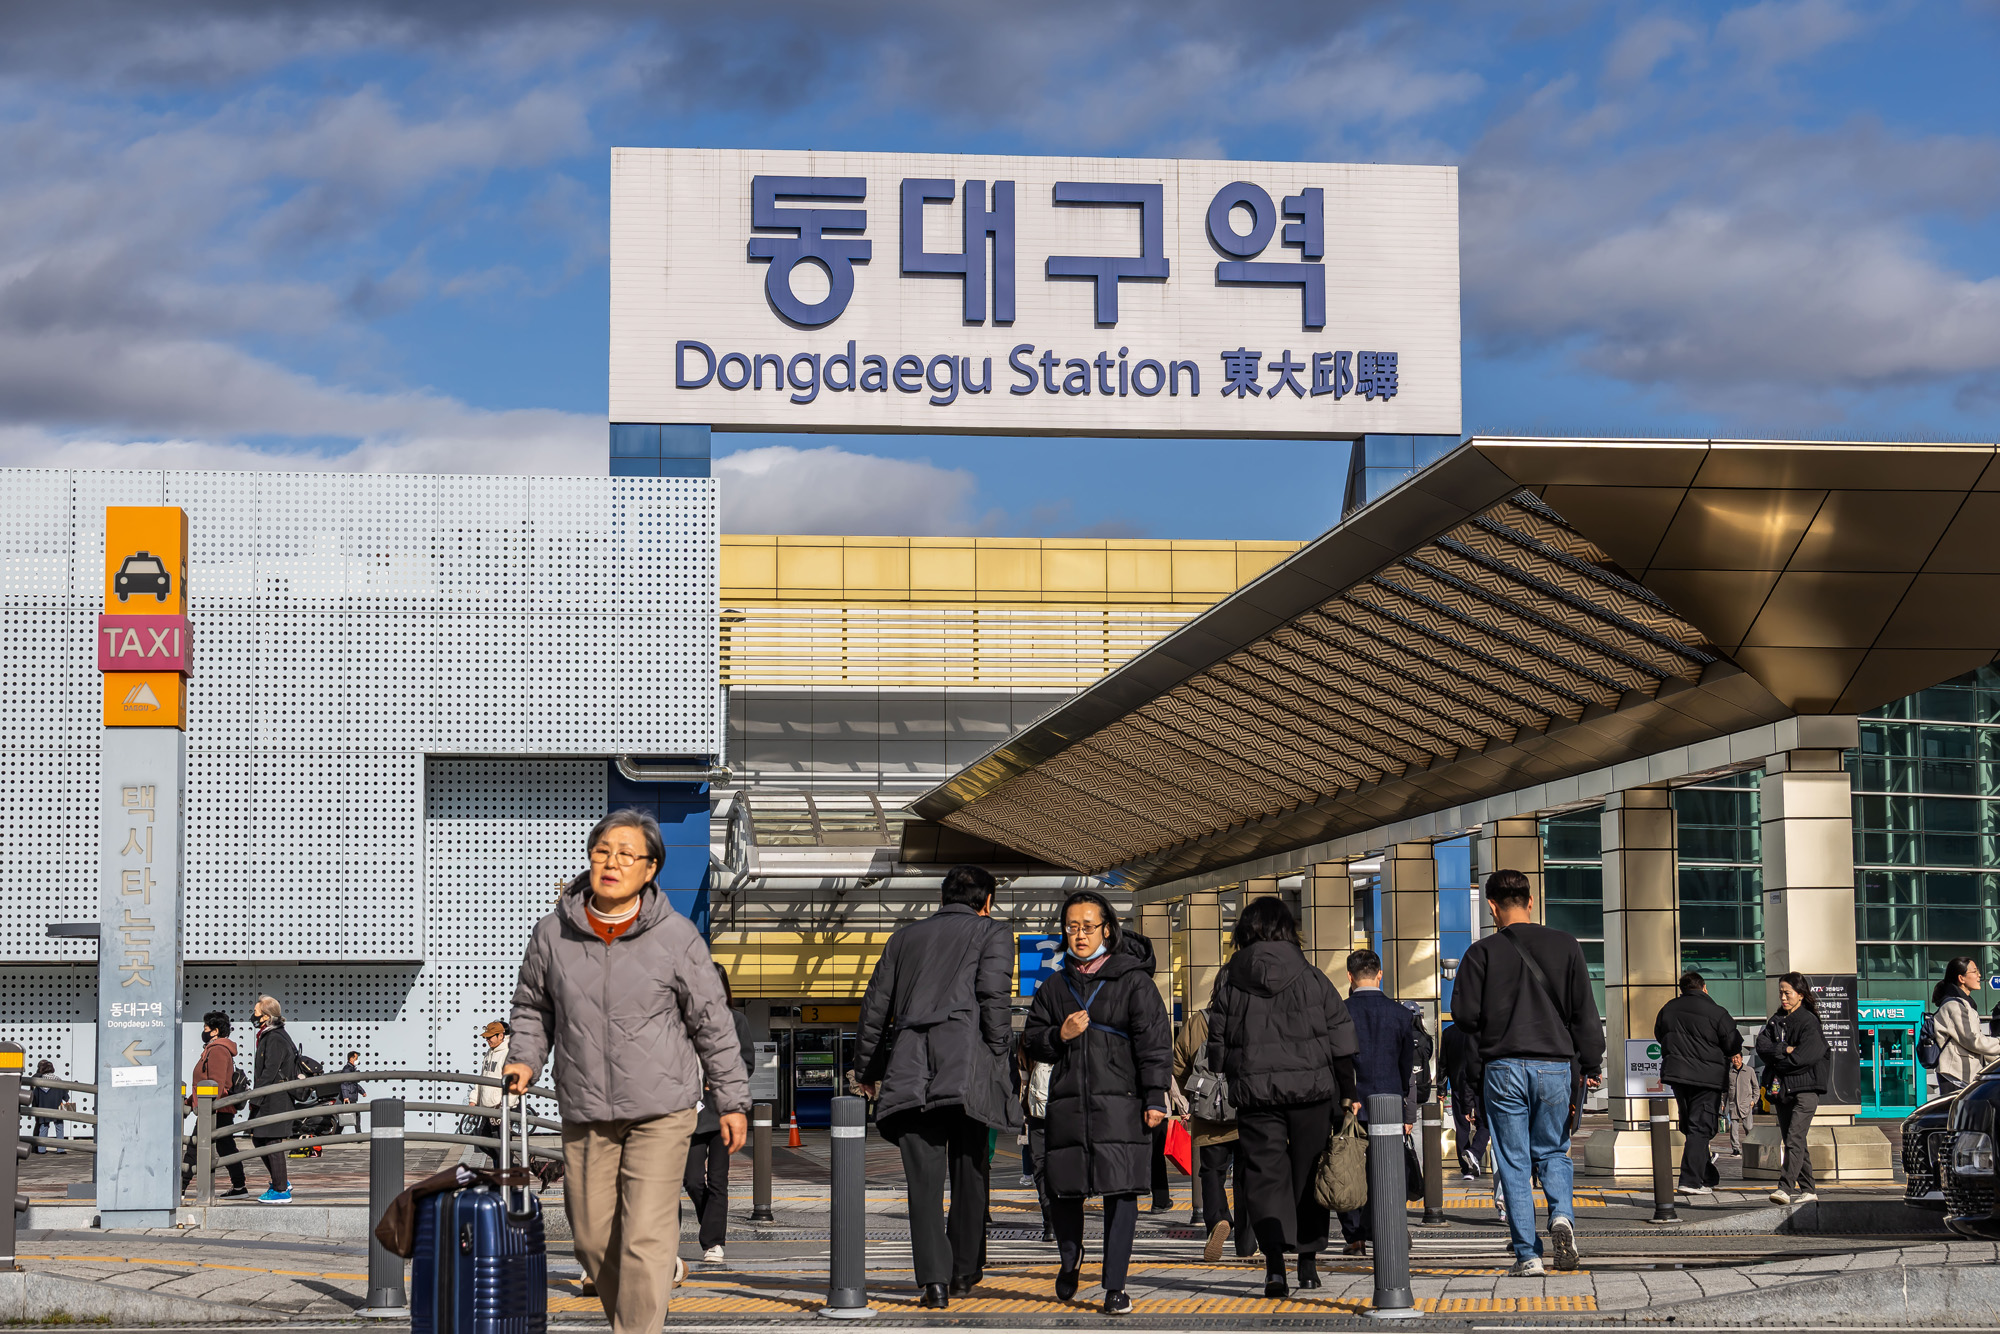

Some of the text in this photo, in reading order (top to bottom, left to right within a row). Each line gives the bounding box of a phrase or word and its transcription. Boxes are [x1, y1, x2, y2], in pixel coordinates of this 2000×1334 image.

[748, 174, 1326, 328] 동대구역
[676, 340, 1200, 405] Dongdaegu Station
[1220, 346, 1399, 403] 東大邱驛
[102, 627, 180, 658] TAXI
[123, 704, 149, 712] DAEGU
[118, 785, 157, 988] 택시타는곳
[110, 1002, 162, 1017] 동대구역
[811, 1007, 819, 1021] 3
[1872, 1008, 1905, 1018] iM뱅크
[107, 1019, 166, 1029] Dongdaegu Stn.
[1631, 1062, 1657, 1071] 흡연구역
